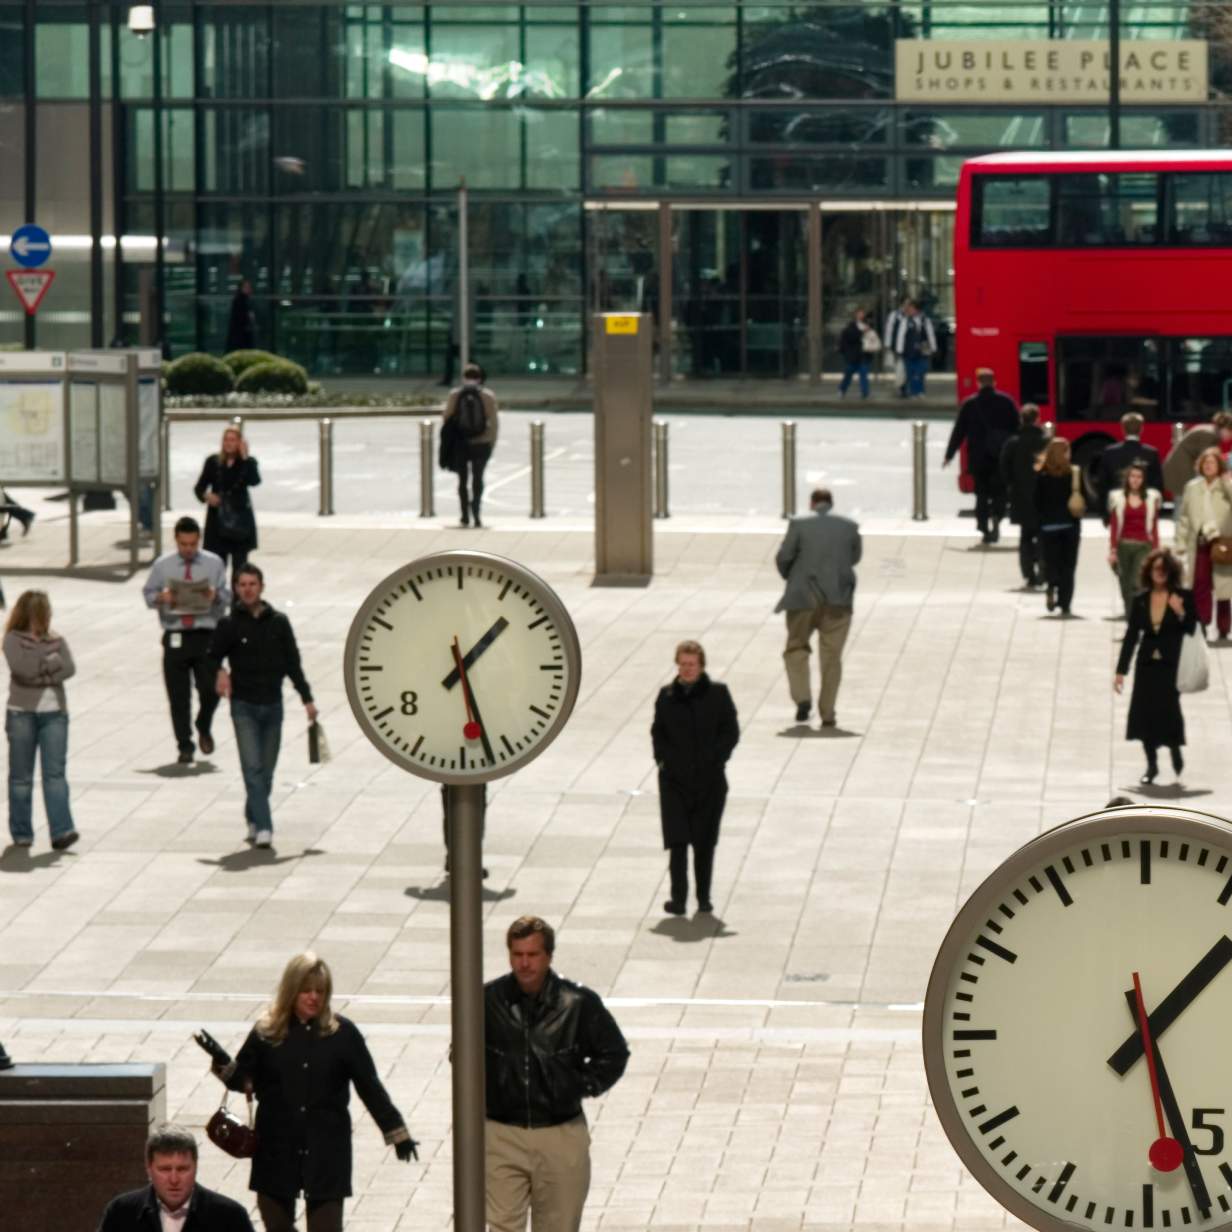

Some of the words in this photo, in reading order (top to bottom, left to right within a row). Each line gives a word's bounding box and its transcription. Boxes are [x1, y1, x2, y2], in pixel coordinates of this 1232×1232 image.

[916, 50, 1060, 75] JUBILEE
[1080, 50, 1190, 71] PLACE
[914, 77, 987, 91] SHOPS
[1002, 77, 1014, 91] &
[1029, 77, 1193, 91] RESTAURANTS
[400, 690, 419, 716] 8
[1191, 1107, 1225, 1156] 5
